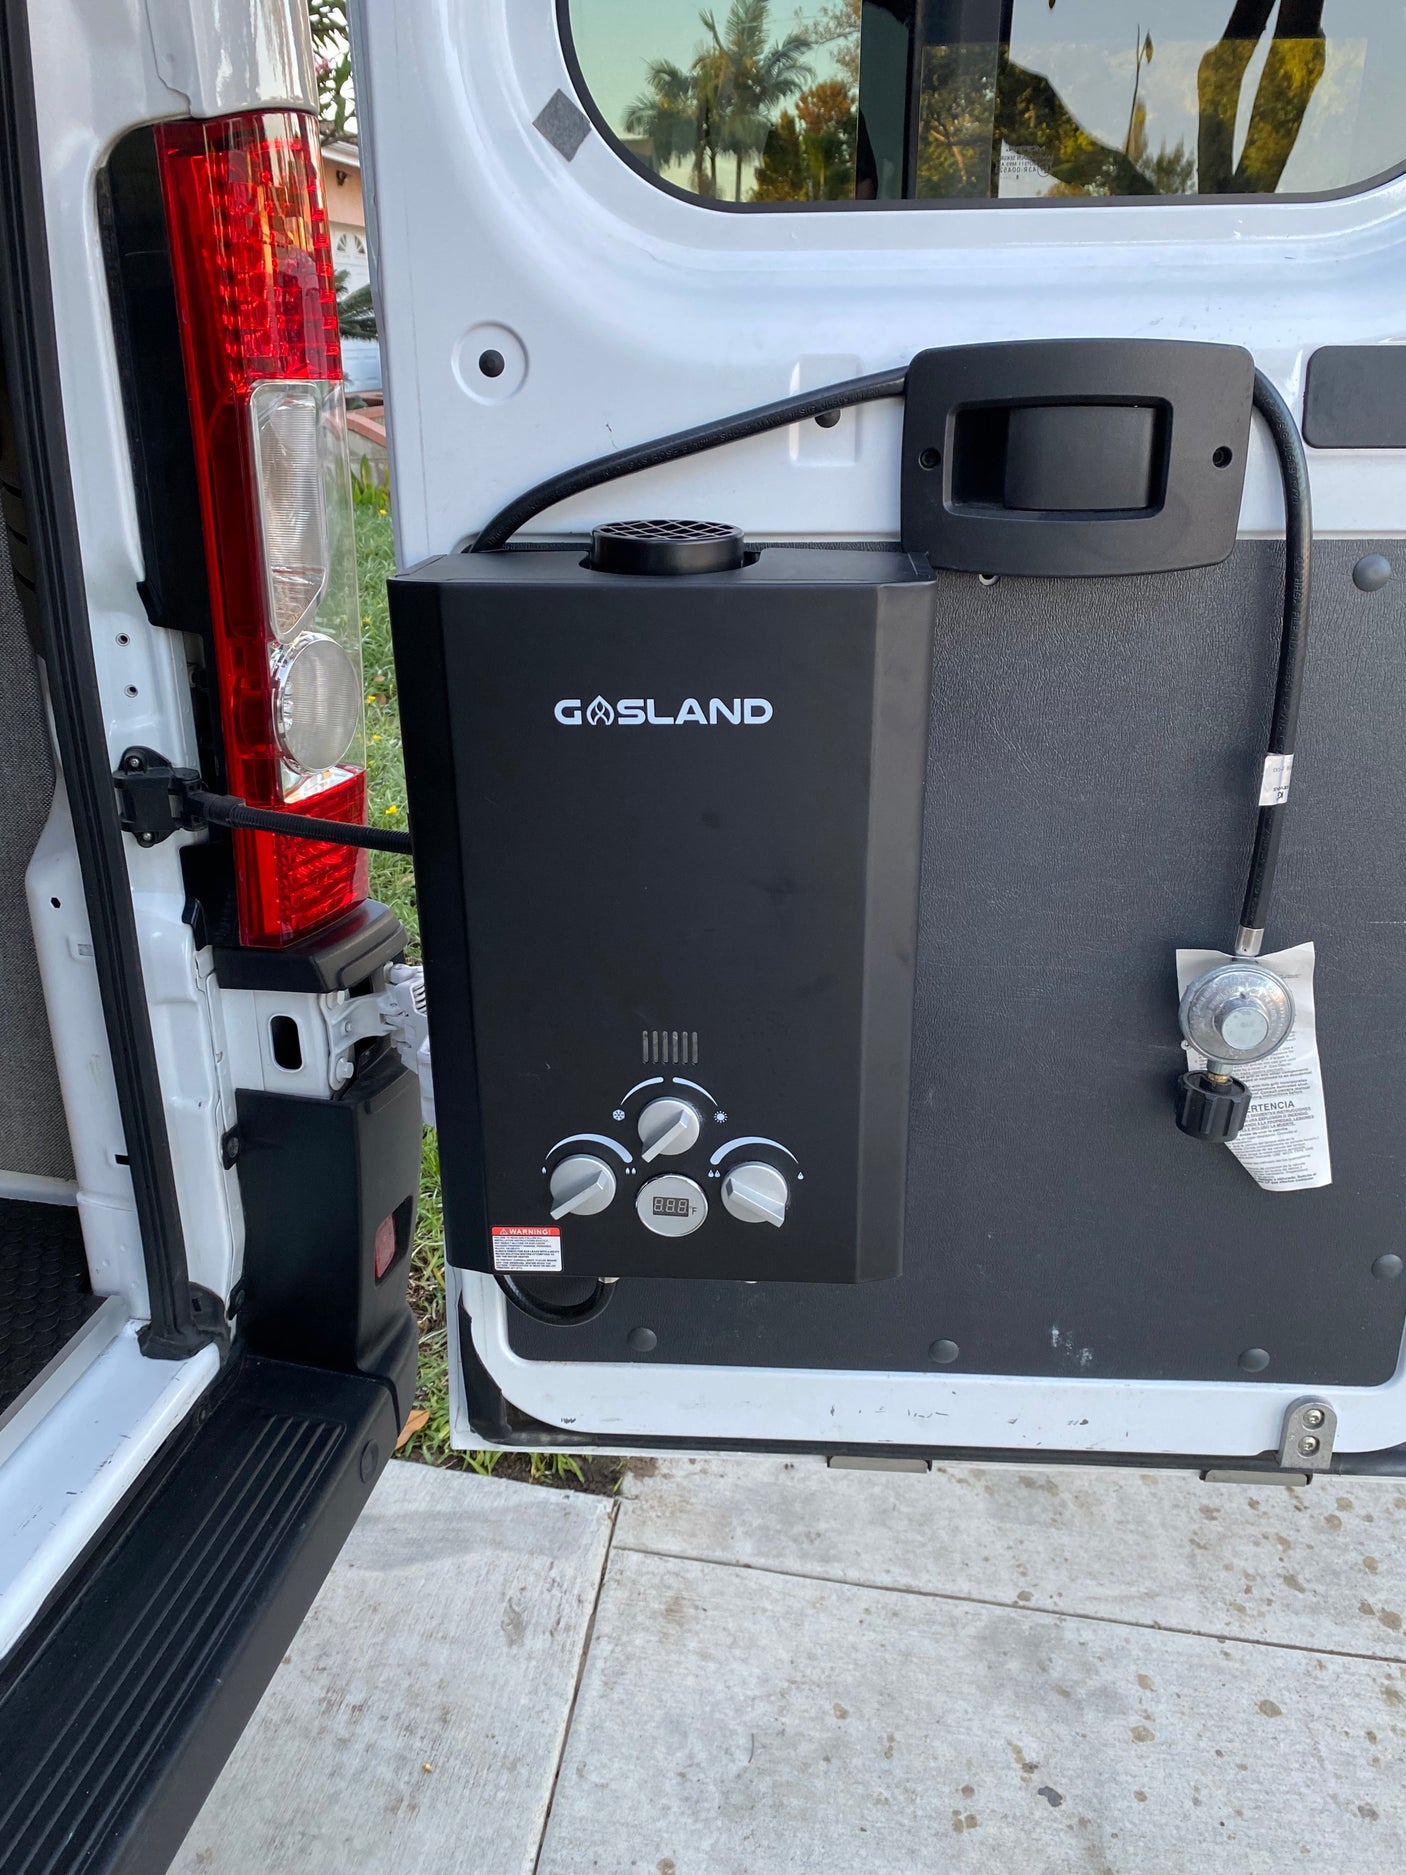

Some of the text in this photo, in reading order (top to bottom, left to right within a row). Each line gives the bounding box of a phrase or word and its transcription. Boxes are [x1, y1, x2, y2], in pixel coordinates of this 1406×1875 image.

[554, 695, 774, 726] GASLAND
[1247, 1100, 1295, 1113] ERTENCIA
[509, 1228, 552, 1236] WARNING!
